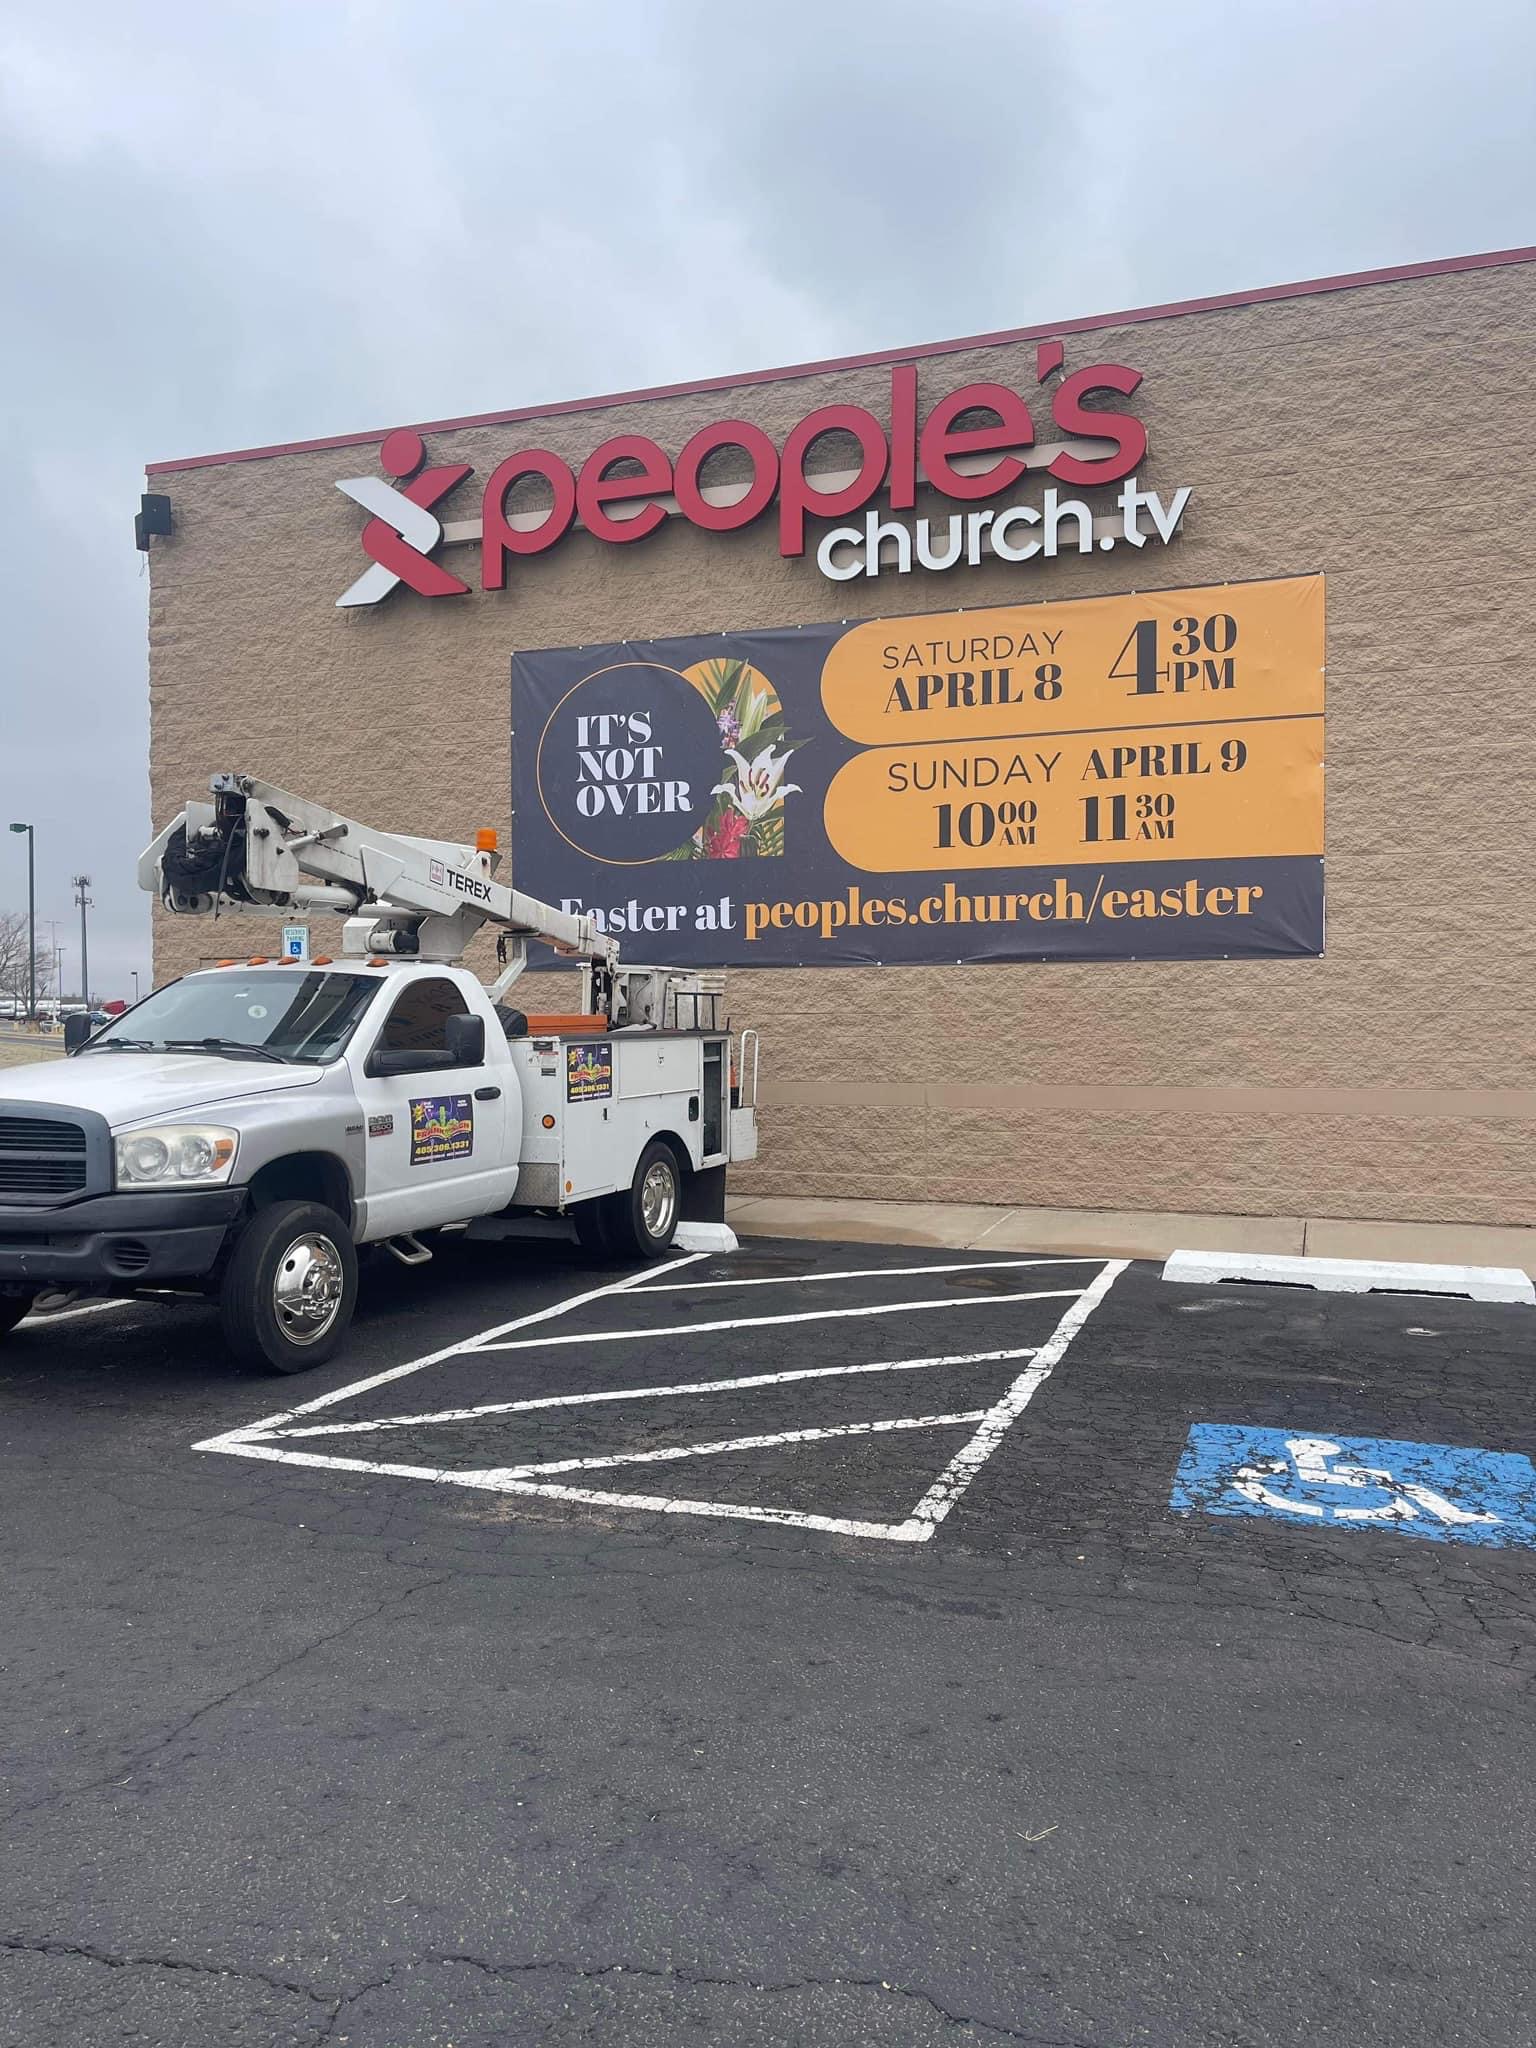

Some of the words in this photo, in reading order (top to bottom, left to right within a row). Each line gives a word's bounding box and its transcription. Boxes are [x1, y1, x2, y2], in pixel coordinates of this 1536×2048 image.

[482, 341, 1147, 591] people's
[817, 477, 1192, 581] church.tv
[883, 630, 1063, 670] SATURDAY
[1107, 619, 1170, 697] 4
[883, 667, 1023, 713] APRIL
[1033, 663, 1063, 701] 8
[1172, 657, 1237, 693] PM
[576, 711, 652, 747] IT'S
[576, 746, 663, 782] NOT
[888, 752, 1062, 792] SUNDAY
[1081, 742, 1210, 781] APRIL
[1219, 739, 1248, 773] 9
[576, 781, 694, 817] OVER
[932, 801, 996, 849] 10
[1077, 793, 1132, 843] 11
[1000, 826, 1036, 847] AM
[1135, 818, 1175, 841] AM
[446, 869, 492, 903] TEREX
[694, 896, 737, 931] at
[744, 874, 1264, 941] peoples.church/easter
